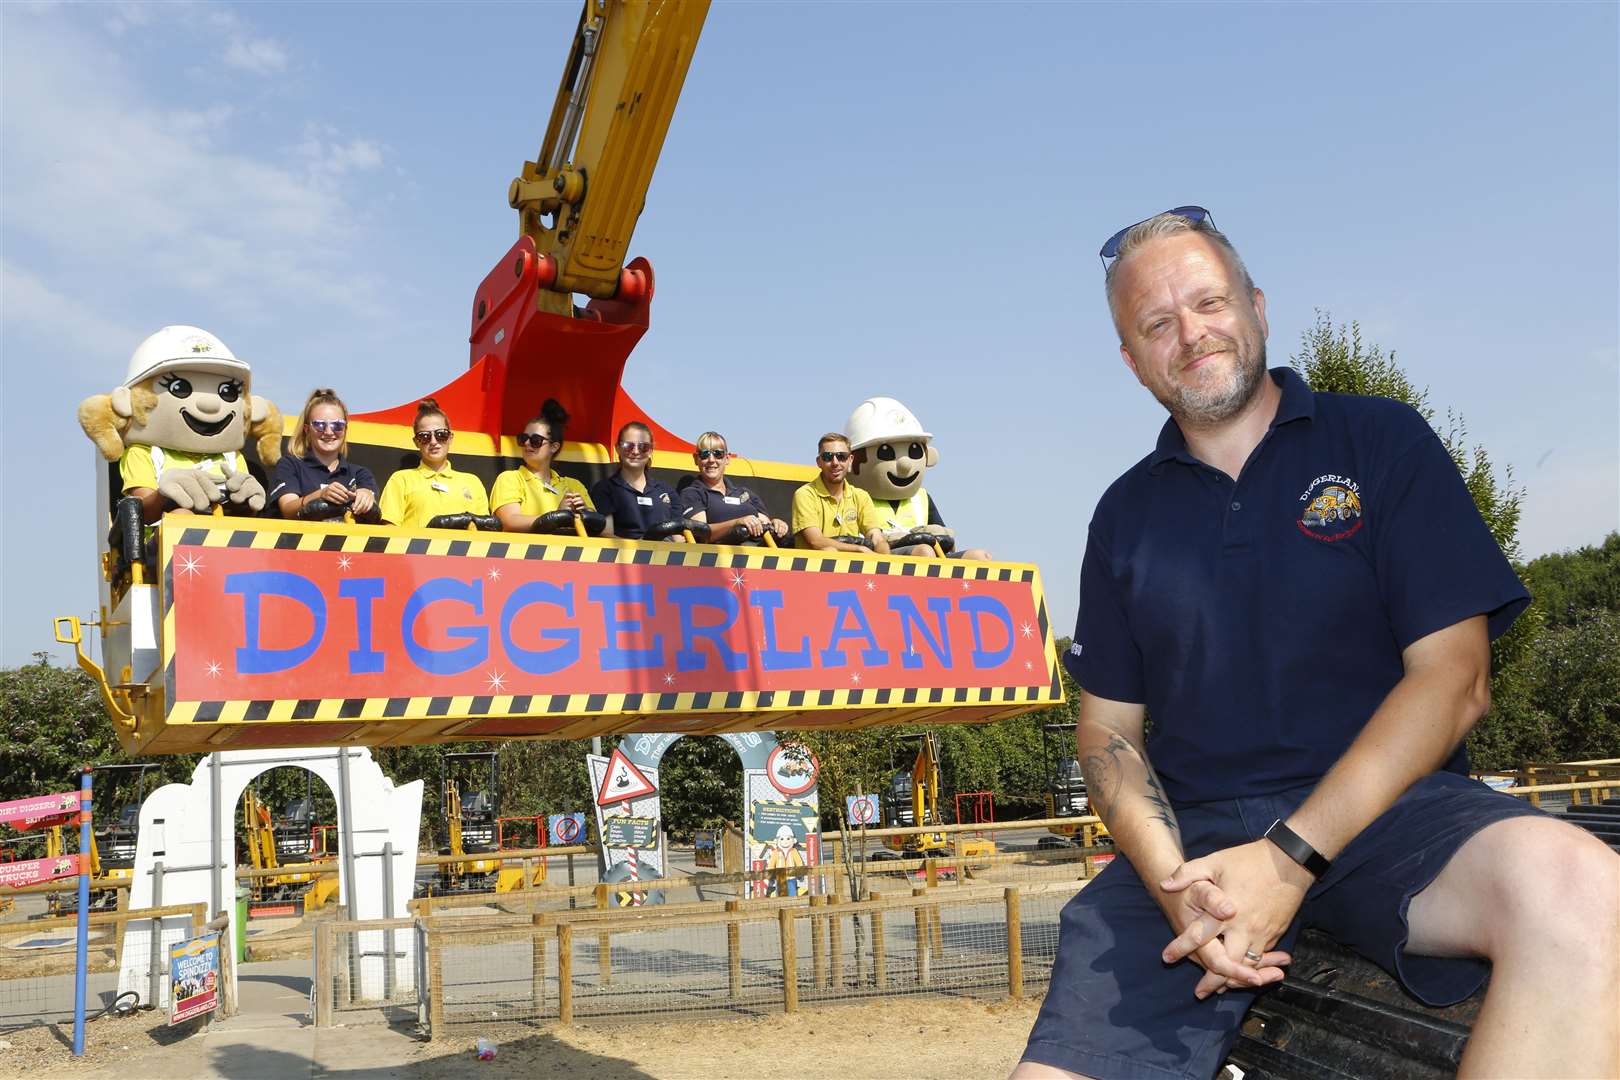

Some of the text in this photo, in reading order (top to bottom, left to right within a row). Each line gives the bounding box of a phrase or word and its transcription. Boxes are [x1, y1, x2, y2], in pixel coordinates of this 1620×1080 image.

[224, 569, 1016, 676] DIGGERLAND
[19, 801, 56, 813] DIGGERS
[0, 870, 39, 882] TRUCKS
[177, 952, 213, 970] WELCOME TO
[178, 963, 212, 981] SPINDIZZY
